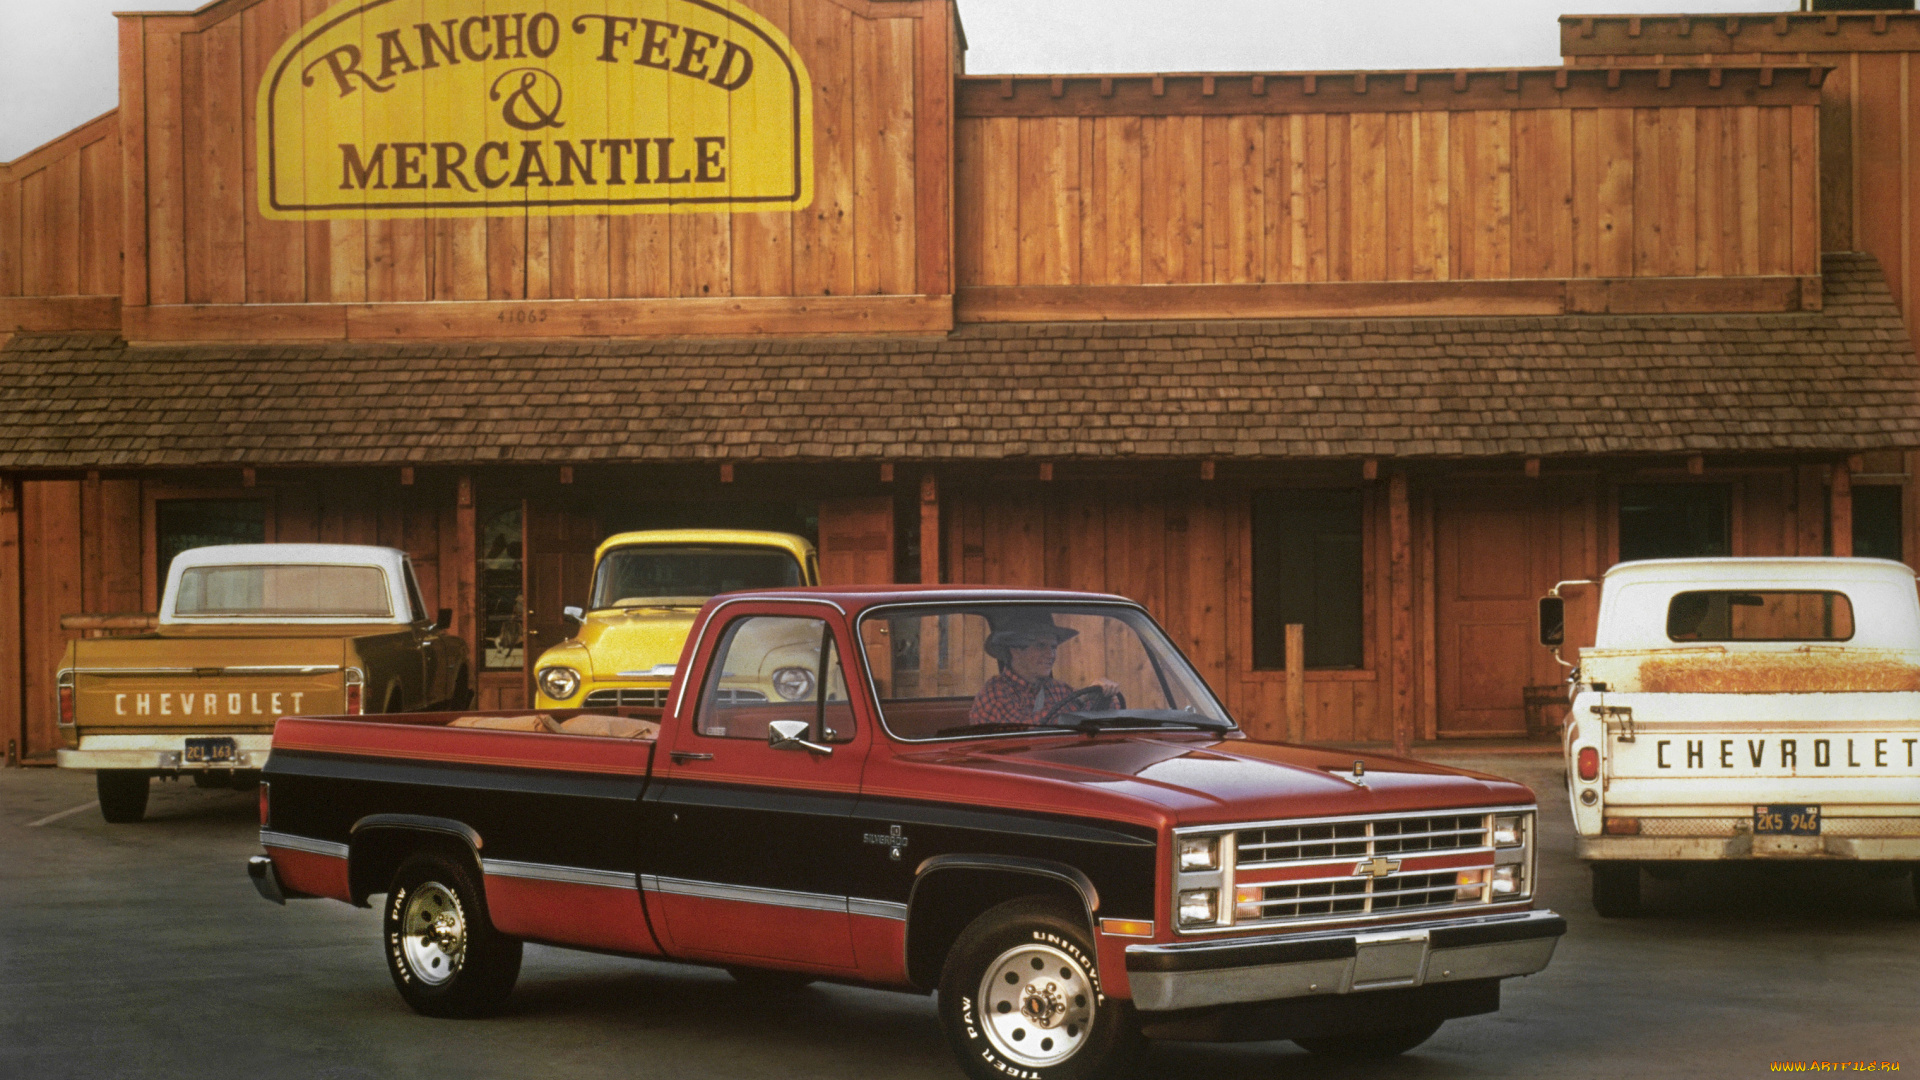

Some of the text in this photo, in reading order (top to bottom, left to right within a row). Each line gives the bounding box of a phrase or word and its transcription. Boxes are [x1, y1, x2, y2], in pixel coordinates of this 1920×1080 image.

[302, 12, 754, 98] RANCHO FEED
[489, 67, 566, 130] &
[338, 136, 727, 193] MERCANTILE
[115, 691, 304, 716] CHEVROLET
[1657, 738, 1919, 769] CHEVROLET
[1757, 813, 1817, 830] 2K5 946
[962, 996, 1042, 1080] TIGER PAW
